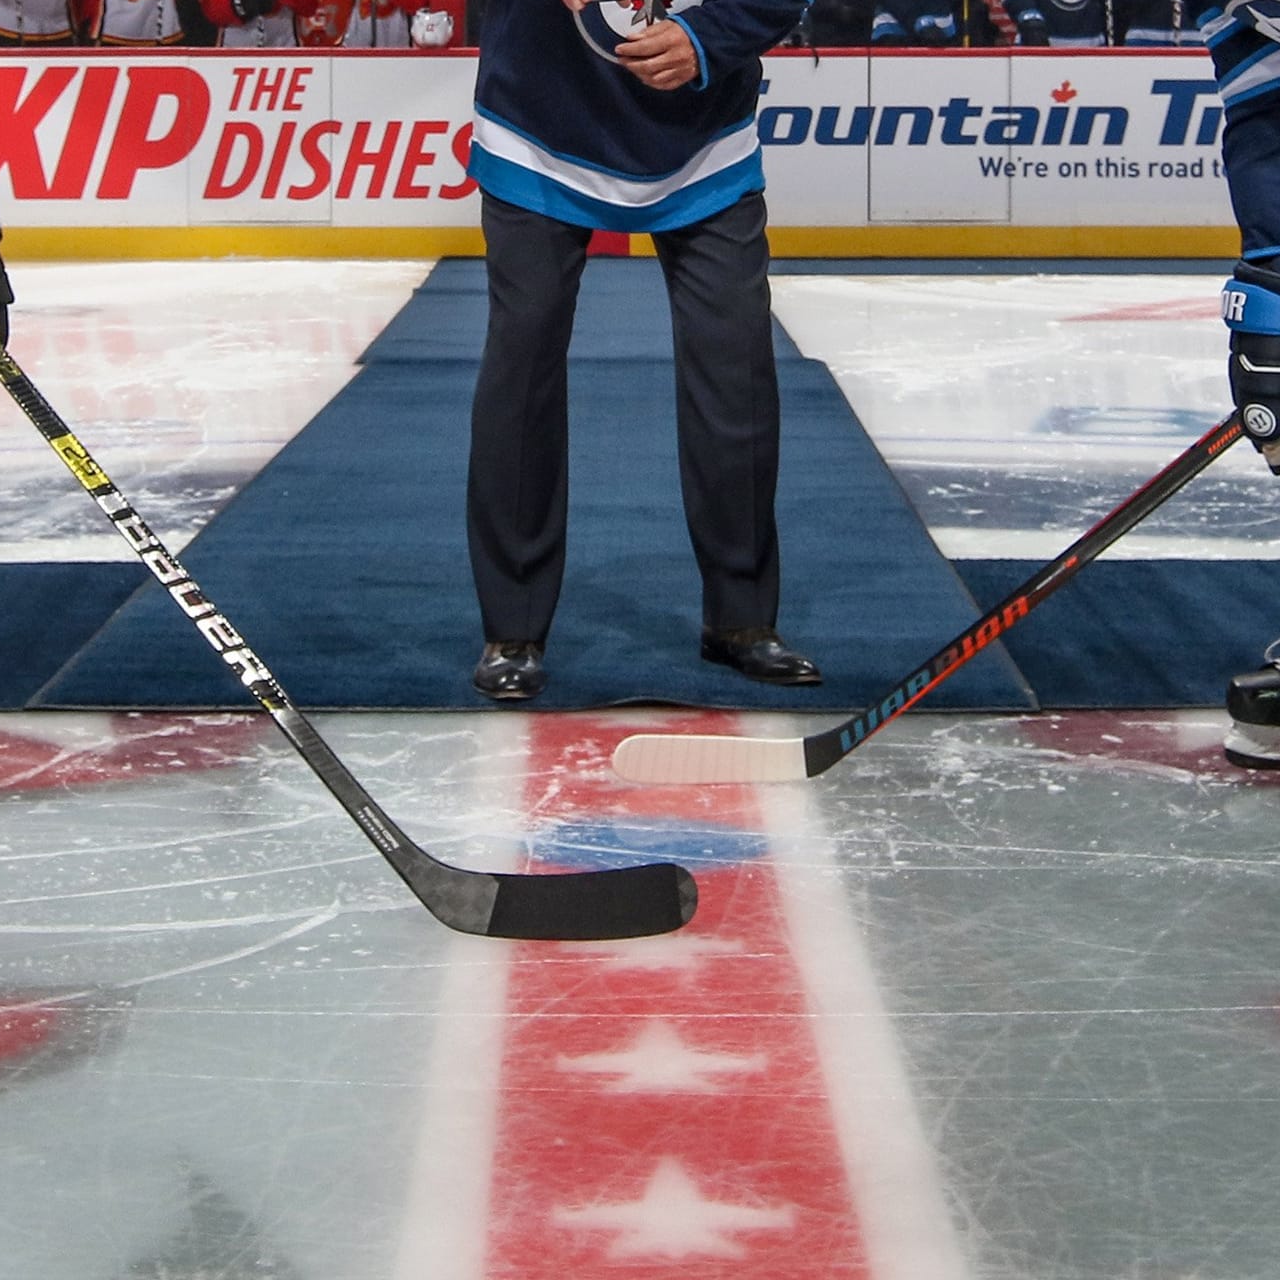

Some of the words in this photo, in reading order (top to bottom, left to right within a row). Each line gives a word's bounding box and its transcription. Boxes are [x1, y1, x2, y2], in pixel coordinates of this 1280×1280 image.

[229, 66, 313, 111] THE
[759, 80, 1129, 145] ountain
[203, 120, 479, 201] DISHES
[979, 156, 1048, 179] We're
[1058, 161, 1088, 179] on
[1095, 156, 1140, 179] this
[1148, 156, 1204, 179] road
[839, 595, 1029, 753] WARRIOR
